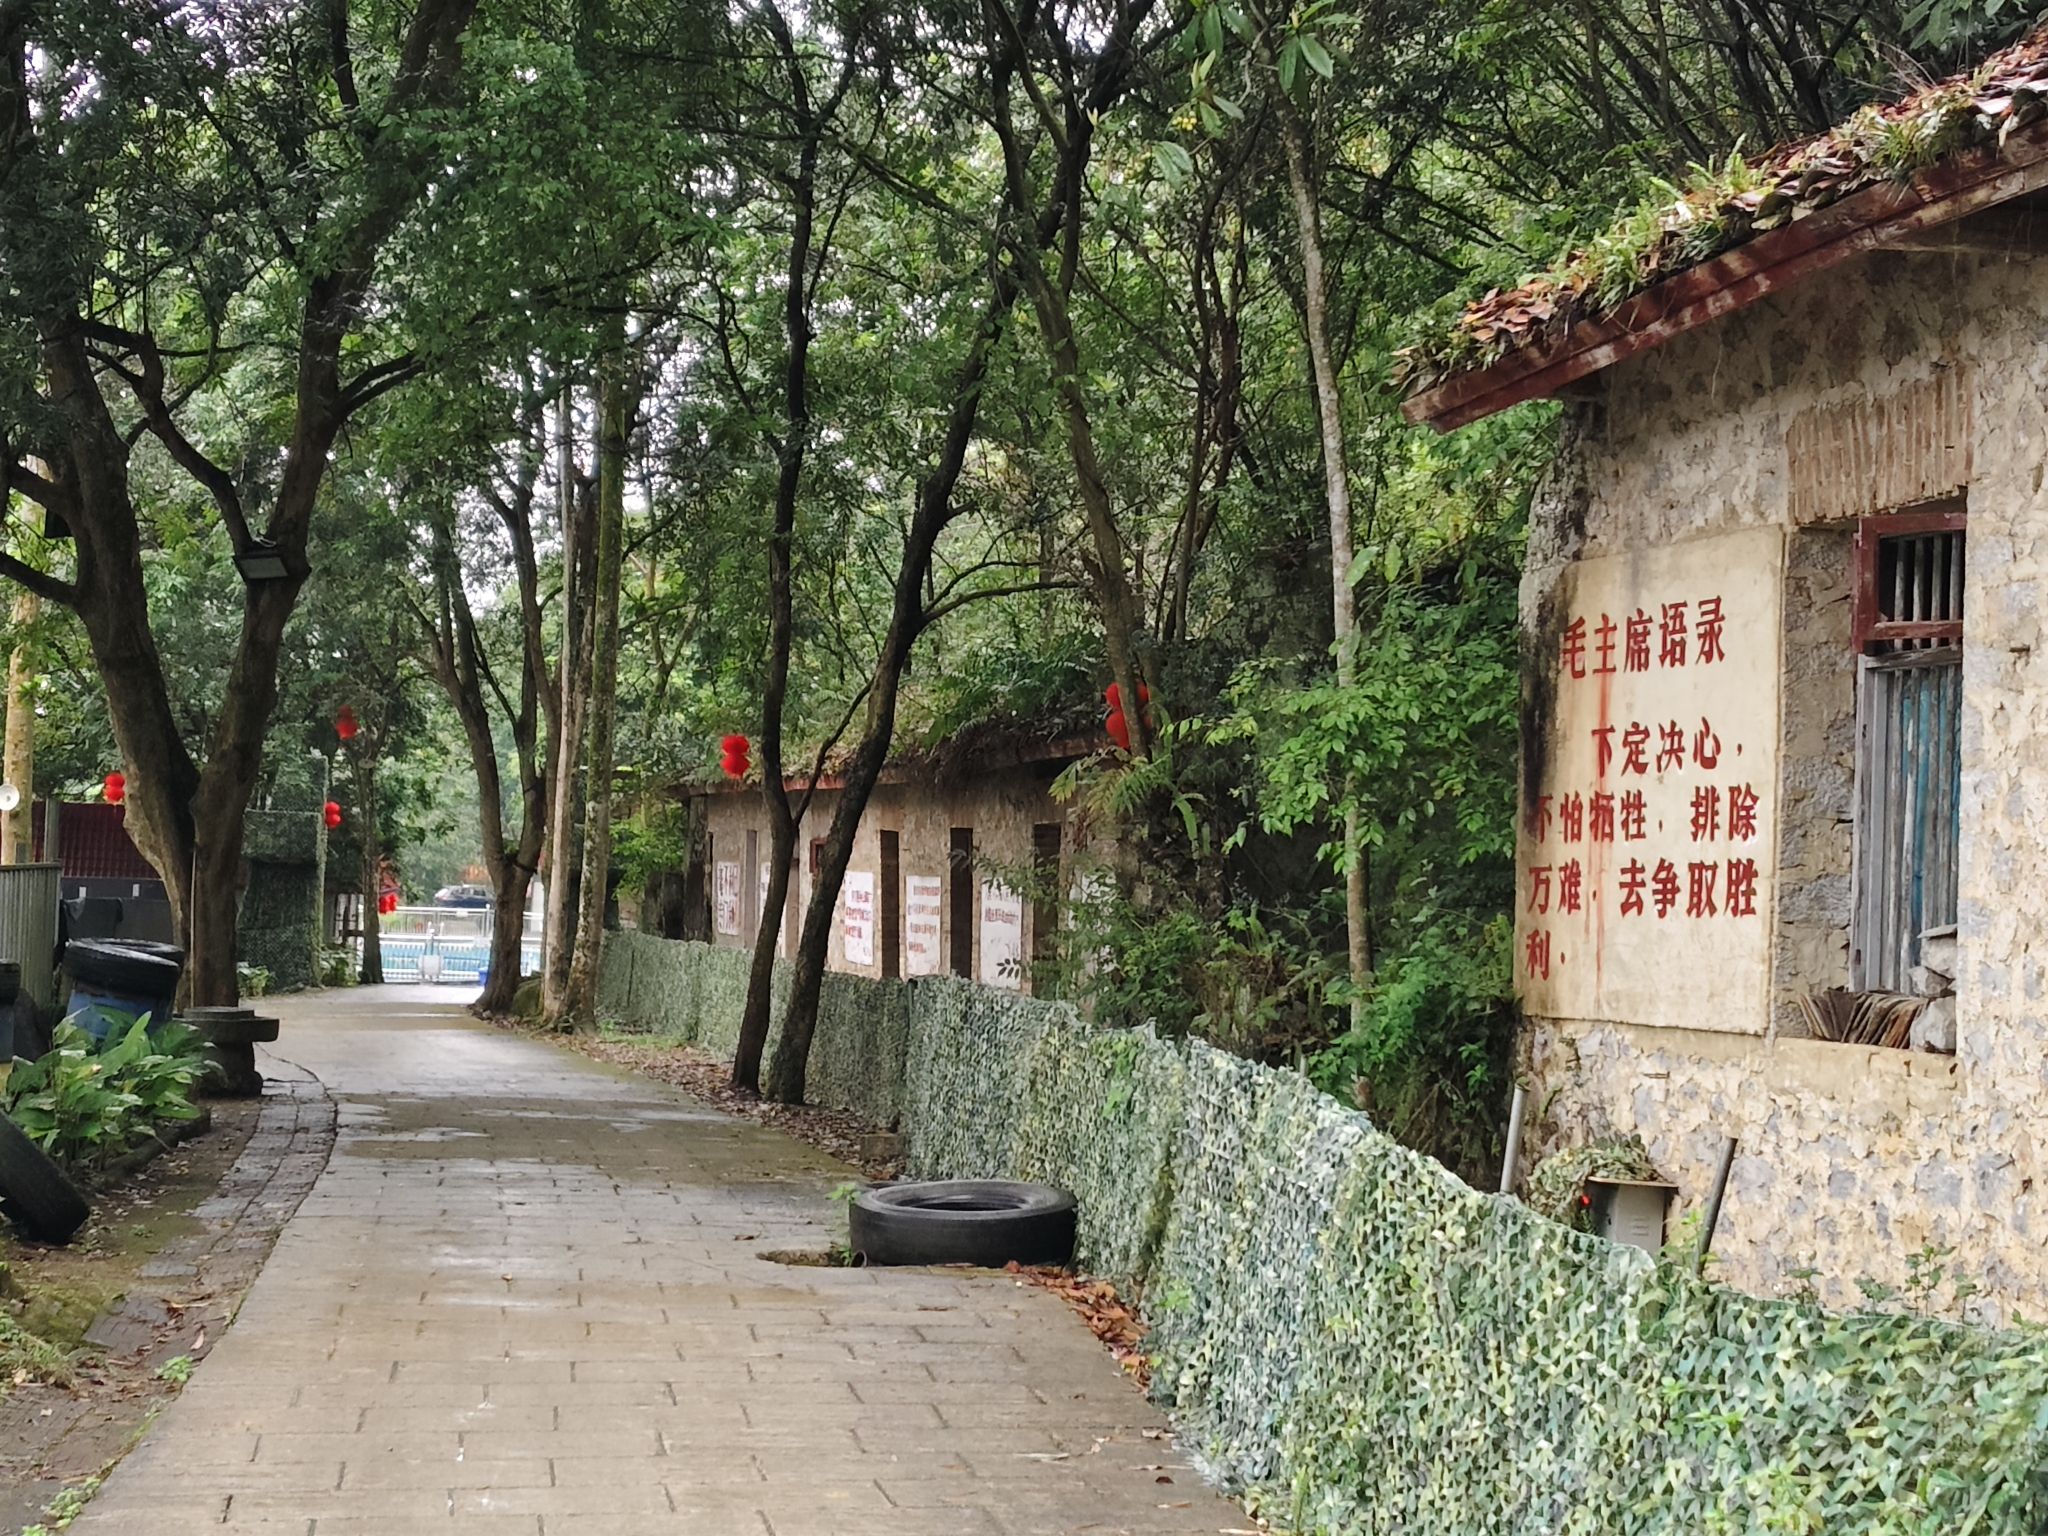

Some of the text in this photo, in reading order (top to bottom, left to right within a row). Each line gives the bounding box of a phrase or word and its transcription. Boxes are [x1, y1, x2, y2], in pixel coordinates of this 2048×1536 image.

[1563, 595, 1726, 679] 毛主席语录
